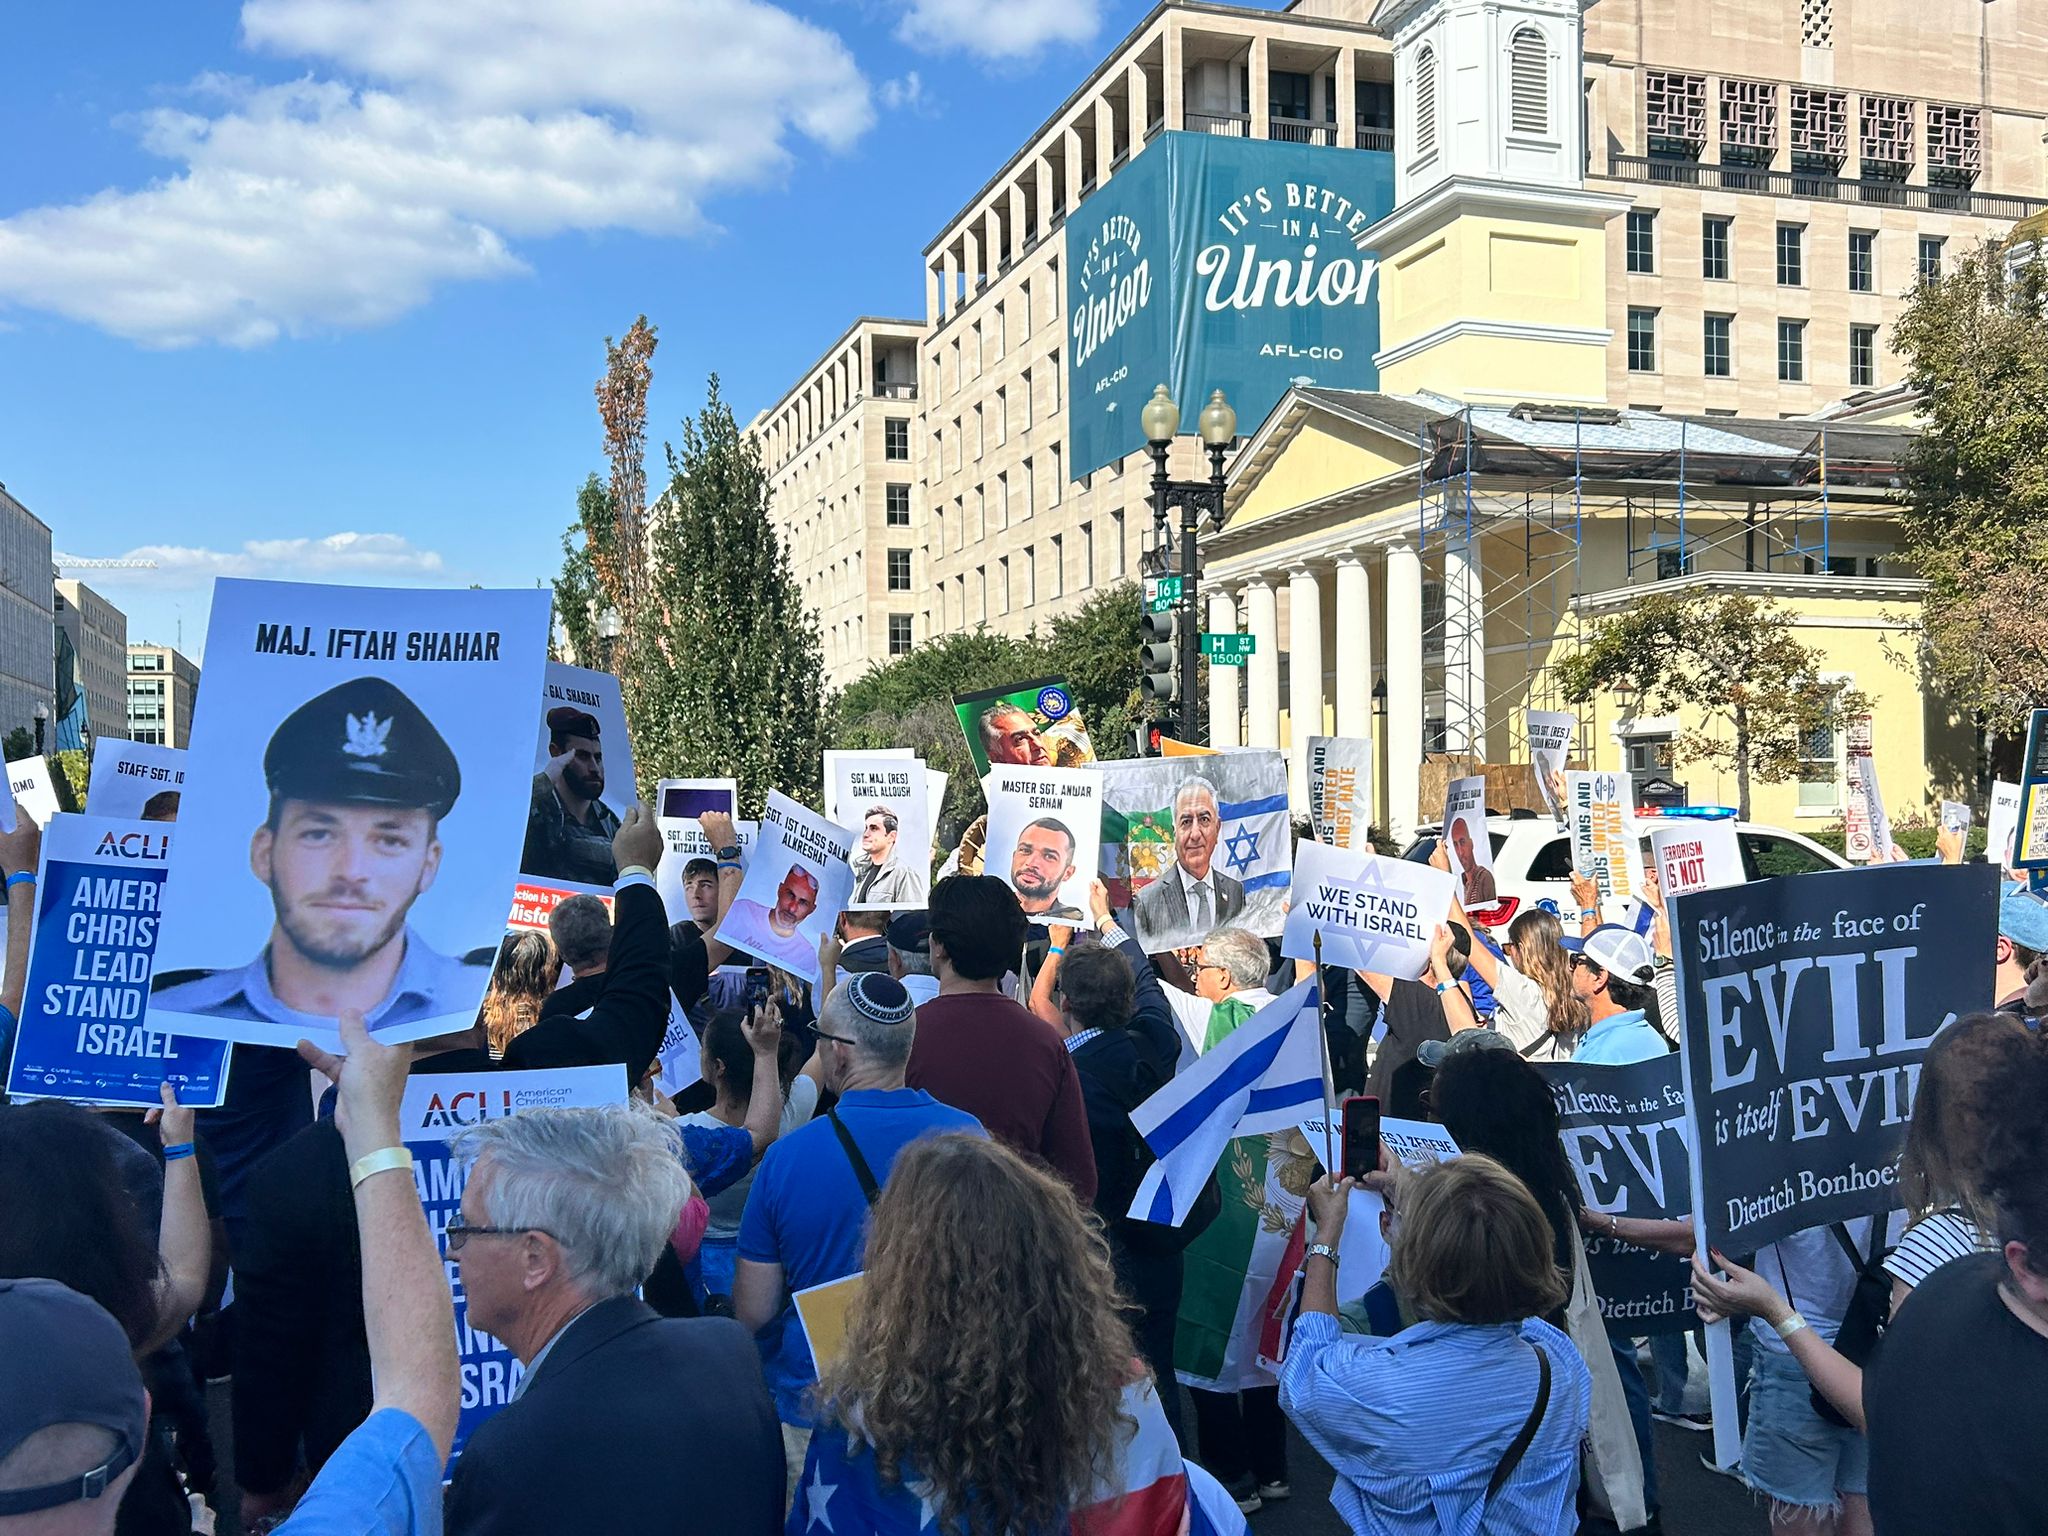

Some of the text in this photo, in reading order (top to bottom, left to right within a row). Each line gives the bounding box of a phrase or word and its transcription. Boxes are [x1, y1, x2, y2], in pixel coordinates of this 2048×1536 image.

[1218, 186, 1272, 236] IT'S
[1282, 219, 1320, 238] IN A
[1079, 215, 1141, 292] IT'S BETTER
[1101, 251, 1118, 275] IN A
[1073, 258, 1152, 368] Union
[1259, 343, 1343, 361] AFL-CIO
[1095, 366, 1128, 394] AFL-CIO
[1159, 581, 1171, 597] 16
[256, 623, 500, 661] MAJ. IFTAH SHAHAR
[1213, 637, 1250, 652] H ST
[1212, 653, 1242, 665] 1500
[549, 685, 601, 708] GAL SHABBAT
[118, 761, 148, 778] STAFF
[151, 768, 171, 783] SGT.
[1314, 747, 1326, 775] AND
[11, 779, 35, 794] OMO
[851, 772, 908, 785] SGT. MAJ. (RES)
[853, 786, 911, 798] DANIEL ALLOUSH
[1002, 780, 1092, 798] MASTER SGT. ANWAR
[1338, 766, 1356, 802] HATE
[1029, 796, 1062, 810] SERHAN
[1323, 768, 1338, 820] UNITED
[1578, 782, 1591, 809] AND
[1998, 797, 2013, 808] CAPT.
[668, 830, 682, 842] SGT.
[765, 806, 782, 826] SGT.
[800, 824, 827, 850] CLASS
[1592, 802, 1607, 852] UNITED
[95, 831, 168, 860] ACLI
[673, 842, 698, 855] NITZAN
[782, 832, 828, 867] ALKRESHAT
[1607, 800, 1631, 896] AGAINST HATE
[1663, 841, 1703, 861] TERRORISM
[1665, 857, 1705, 889] IS NOT
[541, 893, 549, 904] Is
[1318, 885, 1418, 919] WE STAND
[67, 912, 160, 947] CHRIS
[1306, 902, 1427, 941] WITH ISRAEL
[1563, 912, 1575, 920] DC
[1699, 903, 1926, 963] Silence in the face of
[73, 949, 155, 984] LEAD
[43, 983, 141, 1019] STAND
[1702, 947, 1957, 1094] EVIL
[76, 1022, 178, 1059] ISRAEL
[515, 1088, 572, 1098] American
[515, 1096, 566, 1106] Christian
[1625, 1100, 1638, 1114] in
[1640, 1097, 1659, 1112] the
[1663, 1085, 1685, 1107] fa
[1715, 1110, 1728, 1147] is
[1735, 1087, 1784, 1141] itself
[1727, 1179, 1795, 1232] Dietrich
